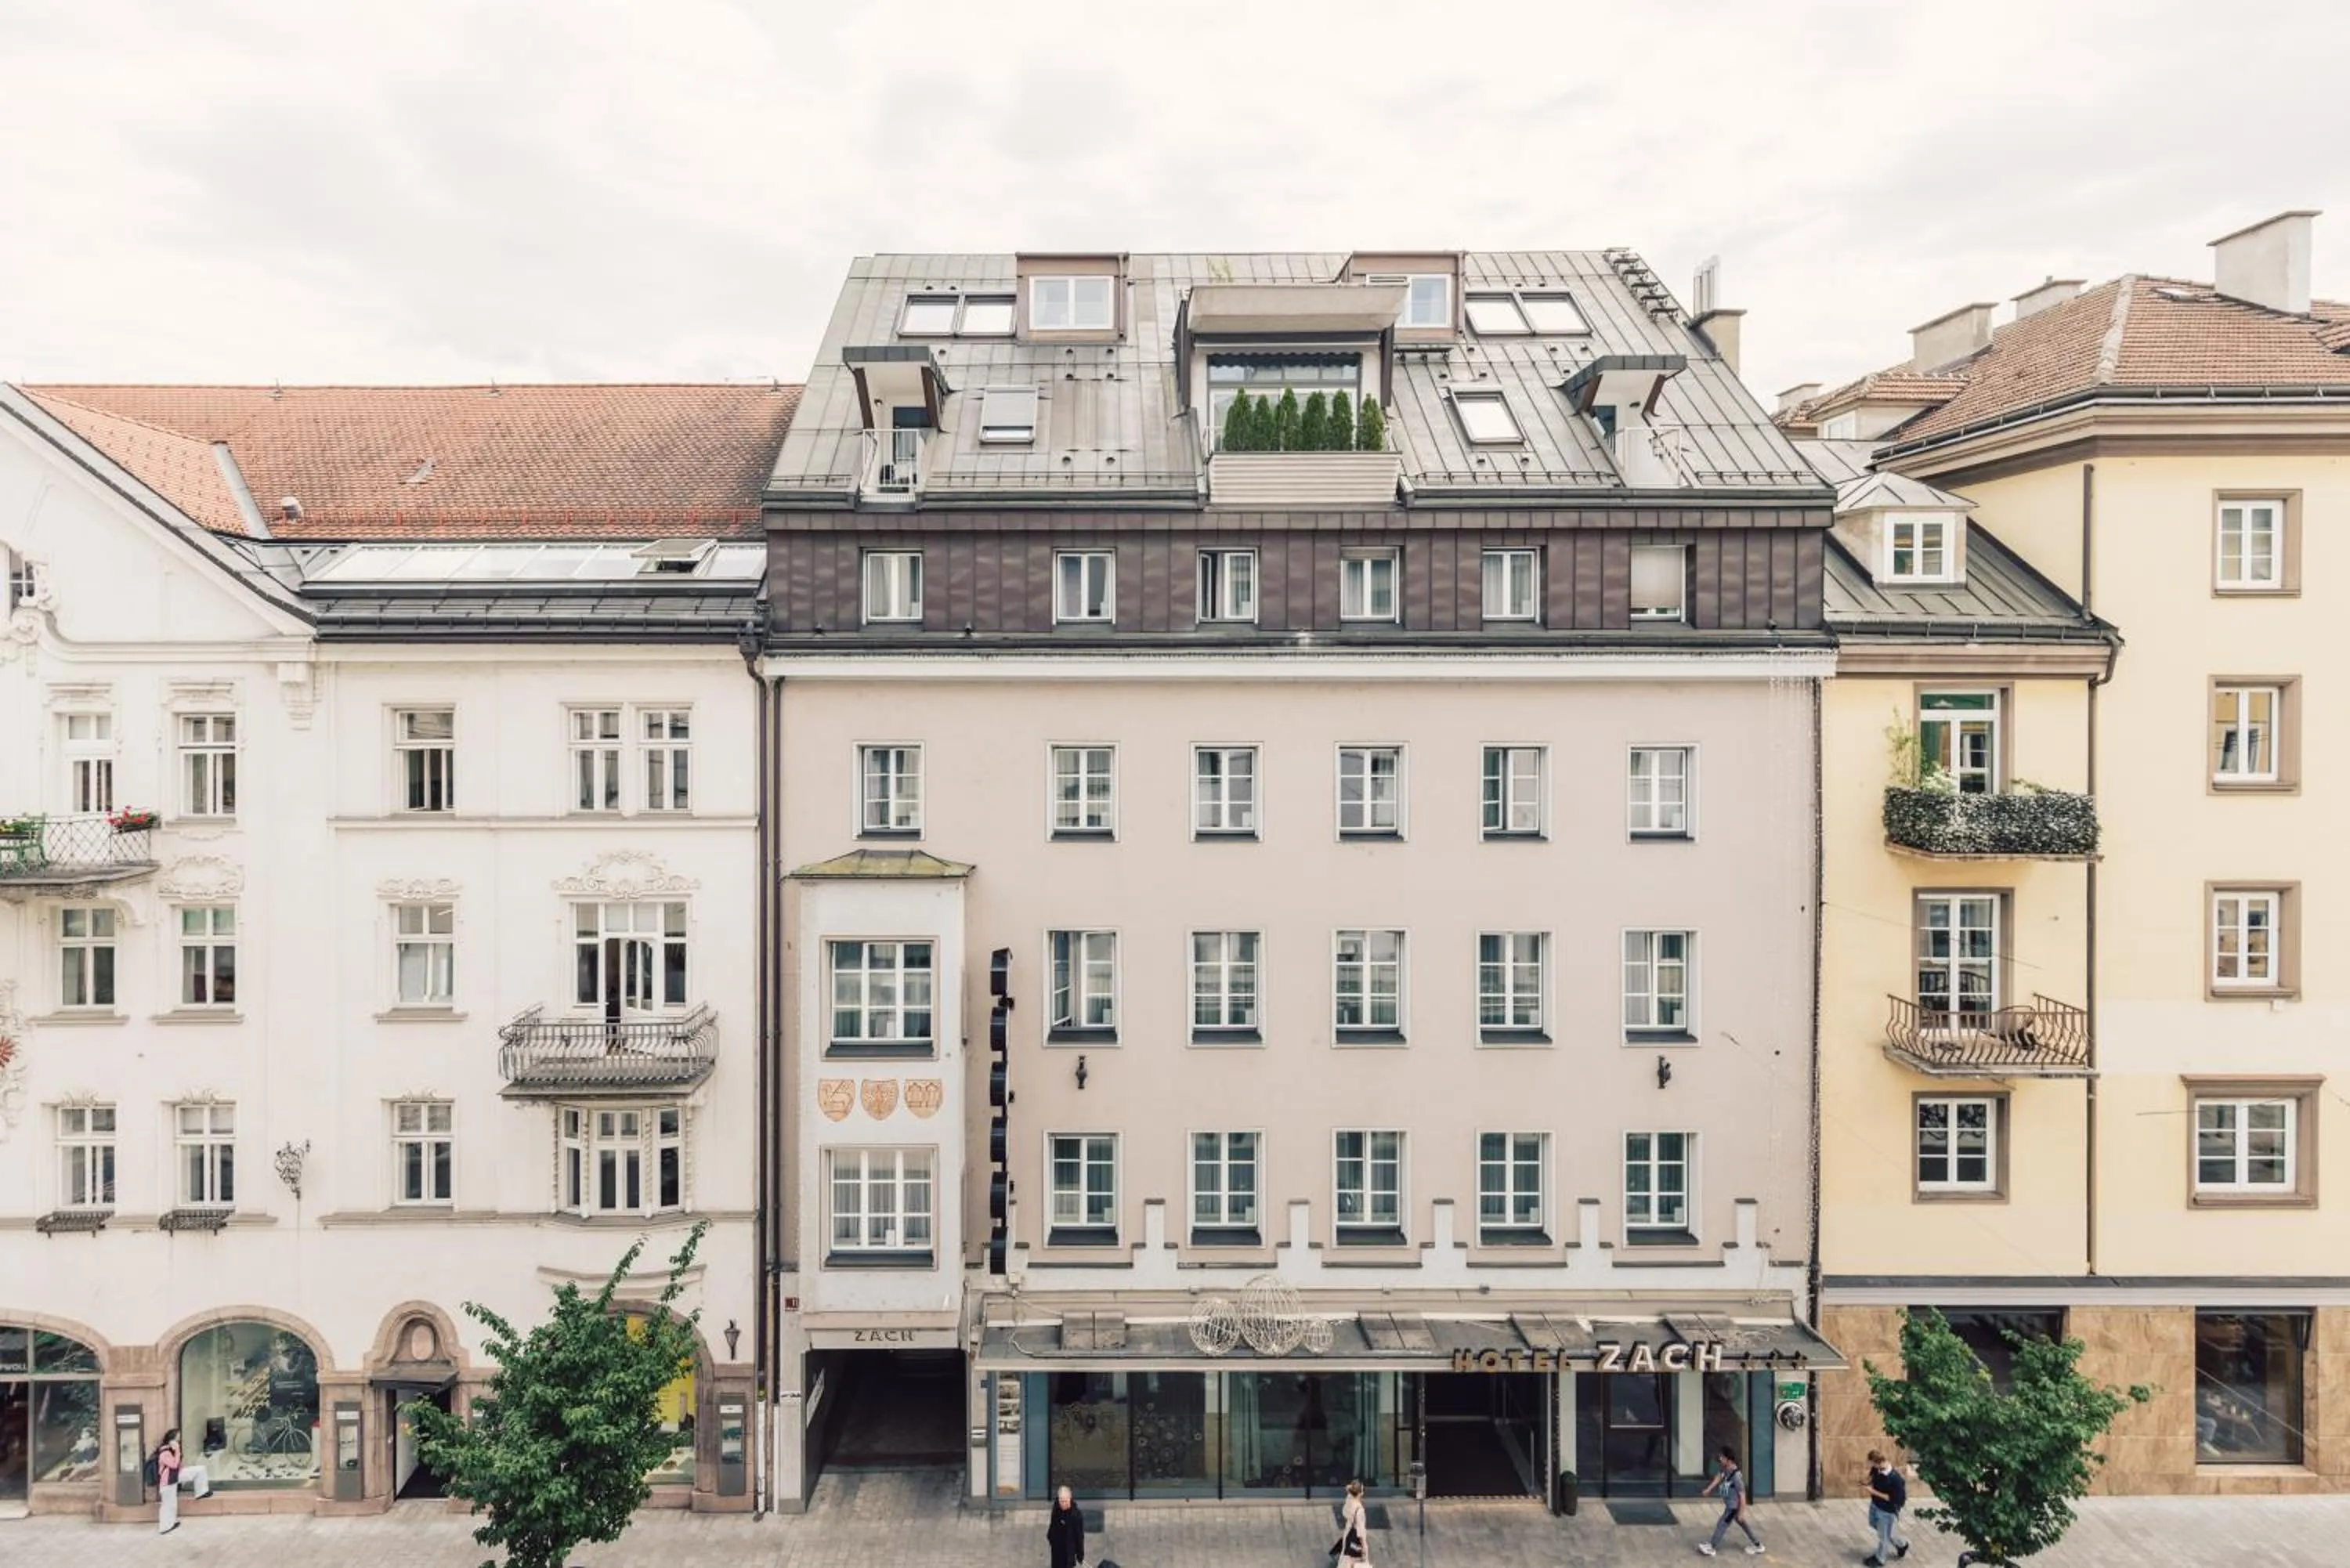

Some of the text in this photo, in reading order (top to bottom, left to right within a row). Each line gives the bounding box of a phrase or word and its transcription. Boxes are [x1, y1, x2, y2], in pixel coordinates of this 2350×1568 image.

[855, 1330, 914, 1342] ZACH
[1453, 1340, 1724, 1372] HOTEL ZACH
